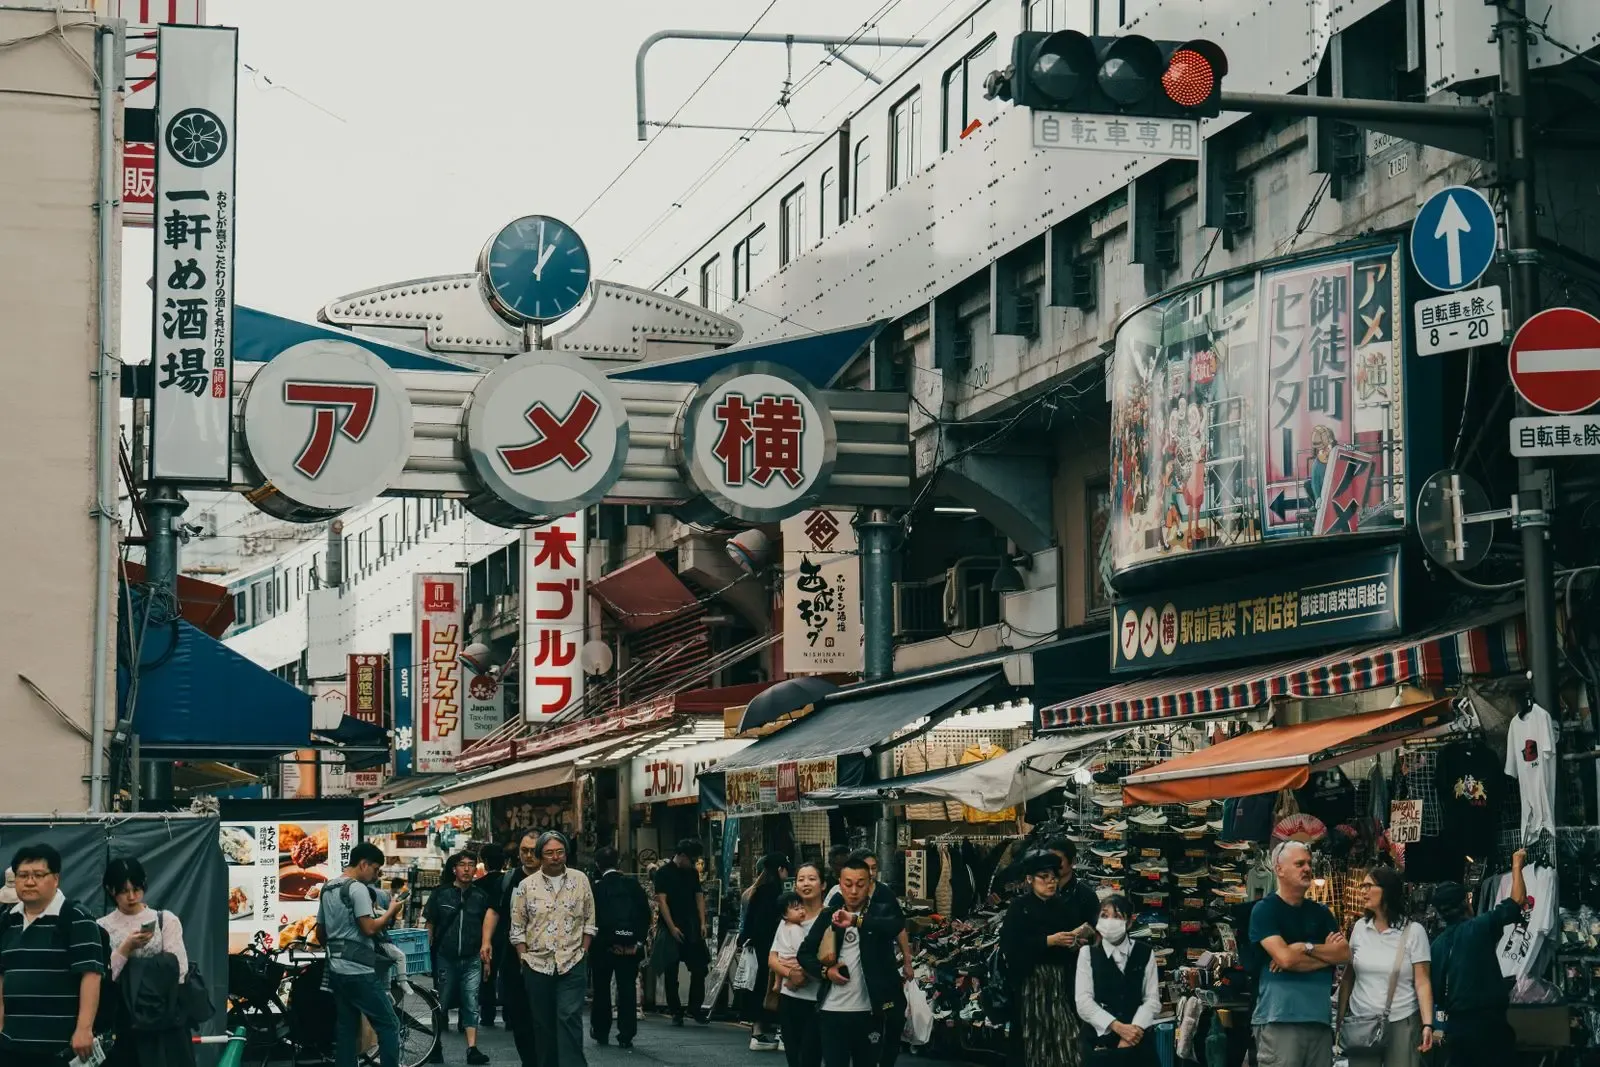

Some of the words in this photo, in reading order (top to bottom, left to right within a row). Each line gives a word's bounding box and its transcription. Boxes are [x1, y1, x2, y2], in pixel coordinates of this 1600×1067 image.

[1041, 117, 1192, 151] 自転車専用
[159, 189, 213, 398] 一軒め酒場
[1421, 295, 1496, 326] 自転車を除く
[1355, 262, 1389, 401] アメ横
[1308, 275, 1347, 421] 御徒町
[1270, 283, 1305, 478] センター
[534, 511, 581, 714] 木ゴルフ
[1300, 581, 1387, 618] 御徒町商栄協同組合
[1125, 612, 1176, 649] アメ横
[1179, 591, 1298, 645] 駅前高架下商店街
[400, 668, 409, 698] OUTLET
[468, 713, 499, 725] Tax-free
[470, 704, 497, 712] Japan.
[474, 722, 493, 732] Shop
[644, 759, 684, 797] 二木ゴルフ
[1392, 801, 1416, 812] BARGAIN
[1400, 810, 1421, 820] SALE
[267, 825, 276, 851] ちくわ
[340, 823, 350, 841] 名物
[340, 843, 350, 872] 神田ヒ
